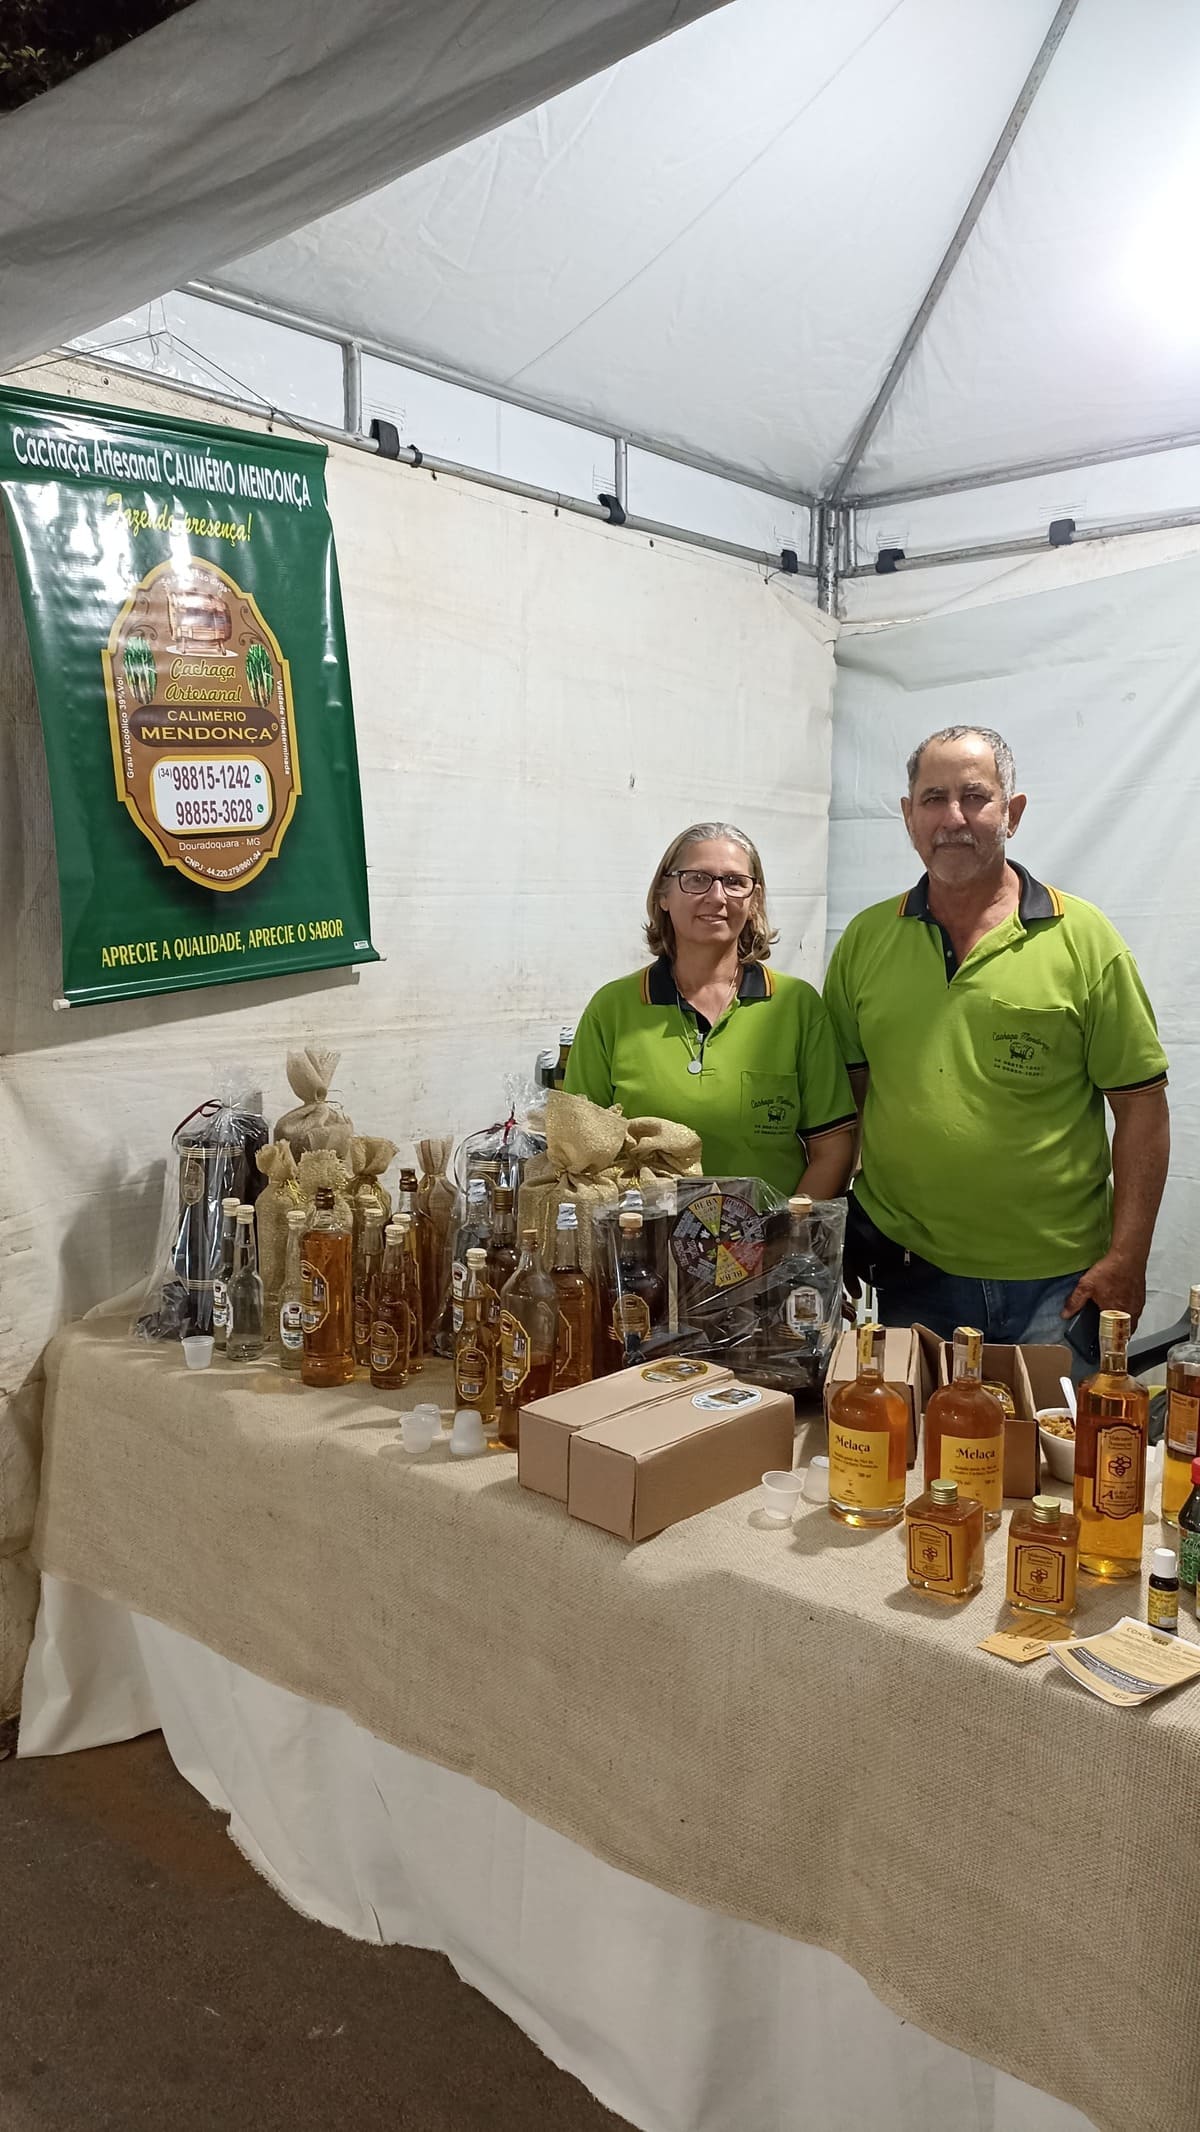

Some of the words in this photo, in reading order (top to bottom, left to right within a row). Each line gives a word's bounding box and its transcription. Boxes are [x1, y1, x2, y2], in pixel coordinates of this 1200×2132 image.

[13, 426, 90, 478] Cachaça
[94, 439, 162, 483] Artesanal
[163, 446, 236, 495] CALIMÉRIO
[238, 463, 312, 512] MENDONÇA
[170, 658, 236, 682] Cachaça
[165, 682, 242, 703] Artesanal
[276, 680, 286, 715] Validade
[167, 708, 247, 722] CALIMÉRIO
[121, 712, 131, 754] Alcoólico
[127, 757, 135, 778] Grau
[173, 765, 251, 790] 98815-1242
[176, 799, 253, 825] 98855-3628
[179, 840, 239, 850] Douradoquara
[246, 837, 261, 846] MG
[102, 942, 159, 968] APRECIE
[162, 941, 171, 960] A
[174, 931, 246, 961] QUALIDADE,
[248, 924, 295, 949] APRECIE
[297, 922, 306, 942] O
[308, 918, 344, 940] SABOR
[834, 1434, 871, 1454] Melaça
[956, 1446, 996, 1460] Melaça
